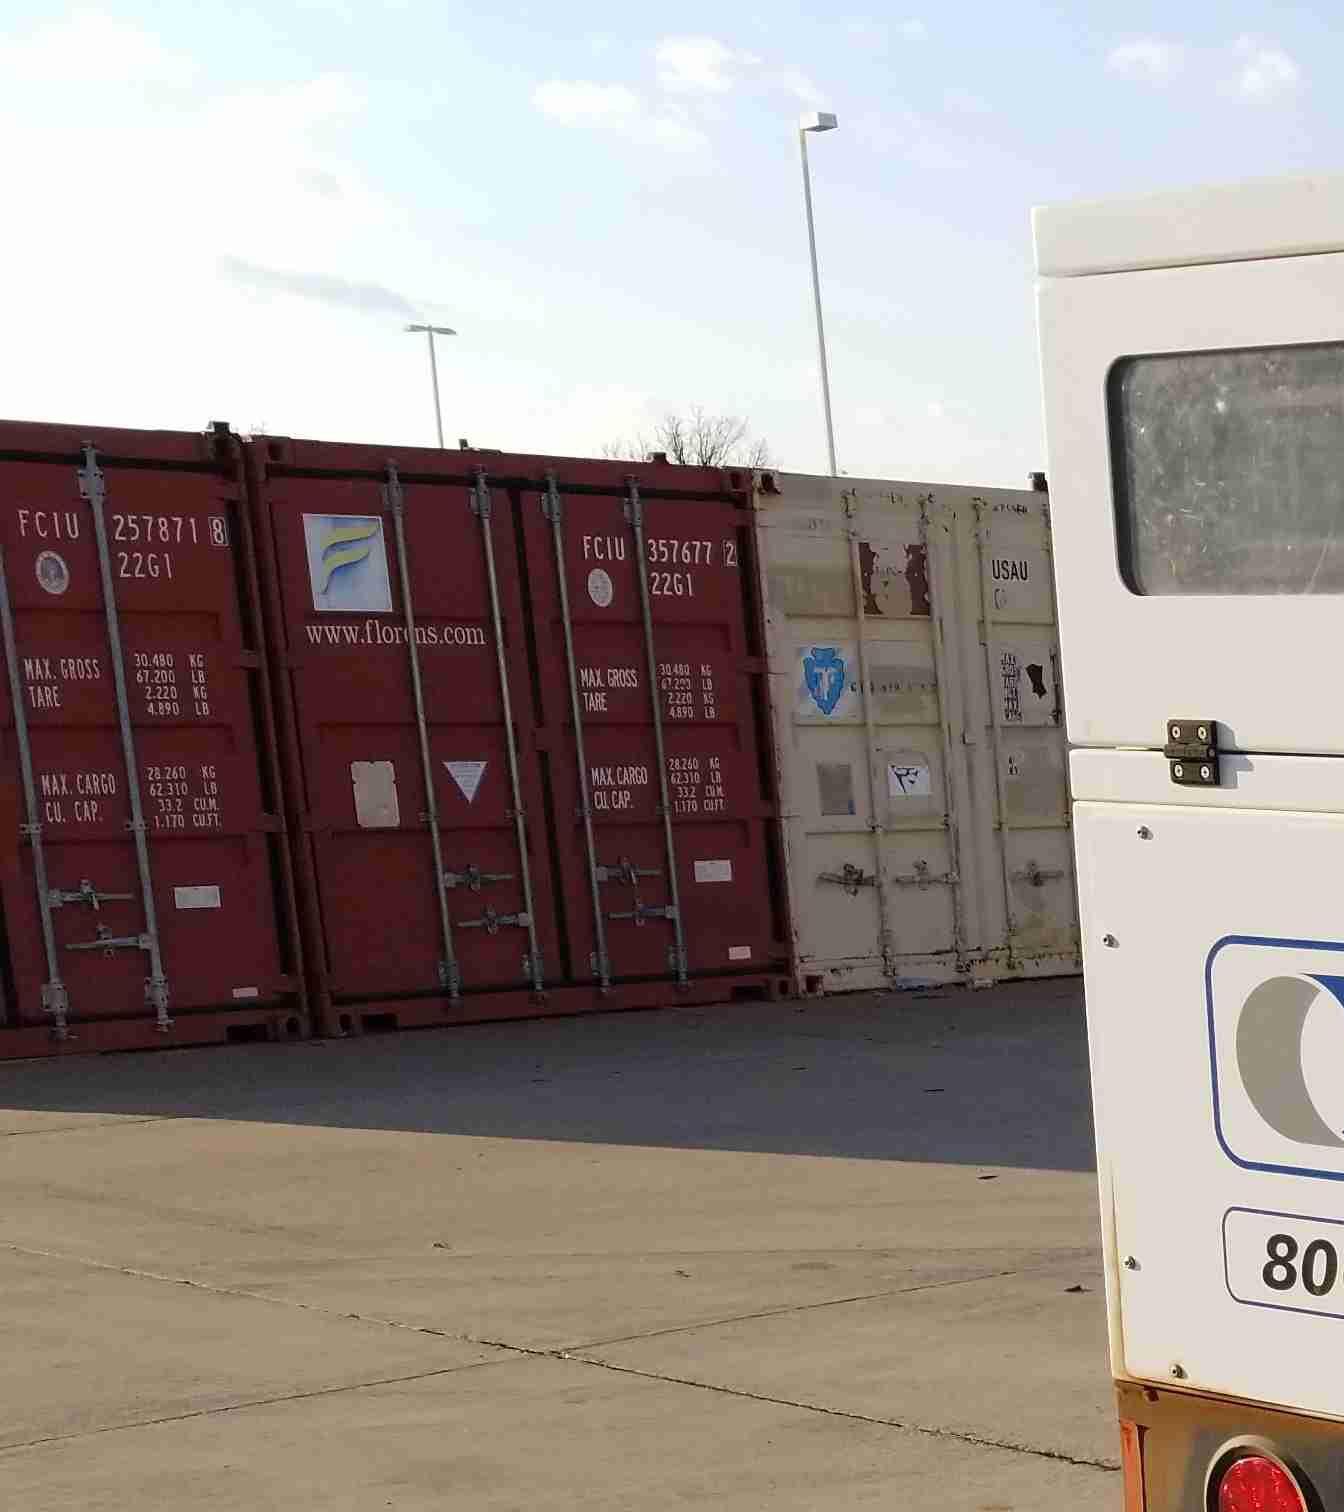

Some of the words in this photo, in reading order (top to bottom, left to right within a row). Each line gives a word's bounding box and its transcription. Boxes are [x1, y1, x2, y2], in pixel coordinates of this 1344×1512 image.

[17, 509, 80, 539] FCIU
[112, 514, 199, 544] 257871
[210, 517, 226, 544] 8
[583, 535, 625, 561] FCIU
[647, 539, 712, 565] 357677
[725, 541, 737, 565] 2
[117, 551, 172, 579] 22G1
[991, 559, 1029, 581] USAU
[650, 572, 694, 597] 22G1
[24, 658, 57, 680] MAX.
[60, 658, 101, 680] GROSS
[188, 654, 204, 667] KG
[191, 670, 206, 684] LB
[580, 668, 605, 688] MAX.
[607, 668, 638, 688] GROSS
[28, 686, 62, 708] TARE
[583, 692, 608, 711] TARE
[41, 774, 73, 796] MAX.
[76, 773, 117, 796] CARGO
[616, 766, 648, 785] CARGO
